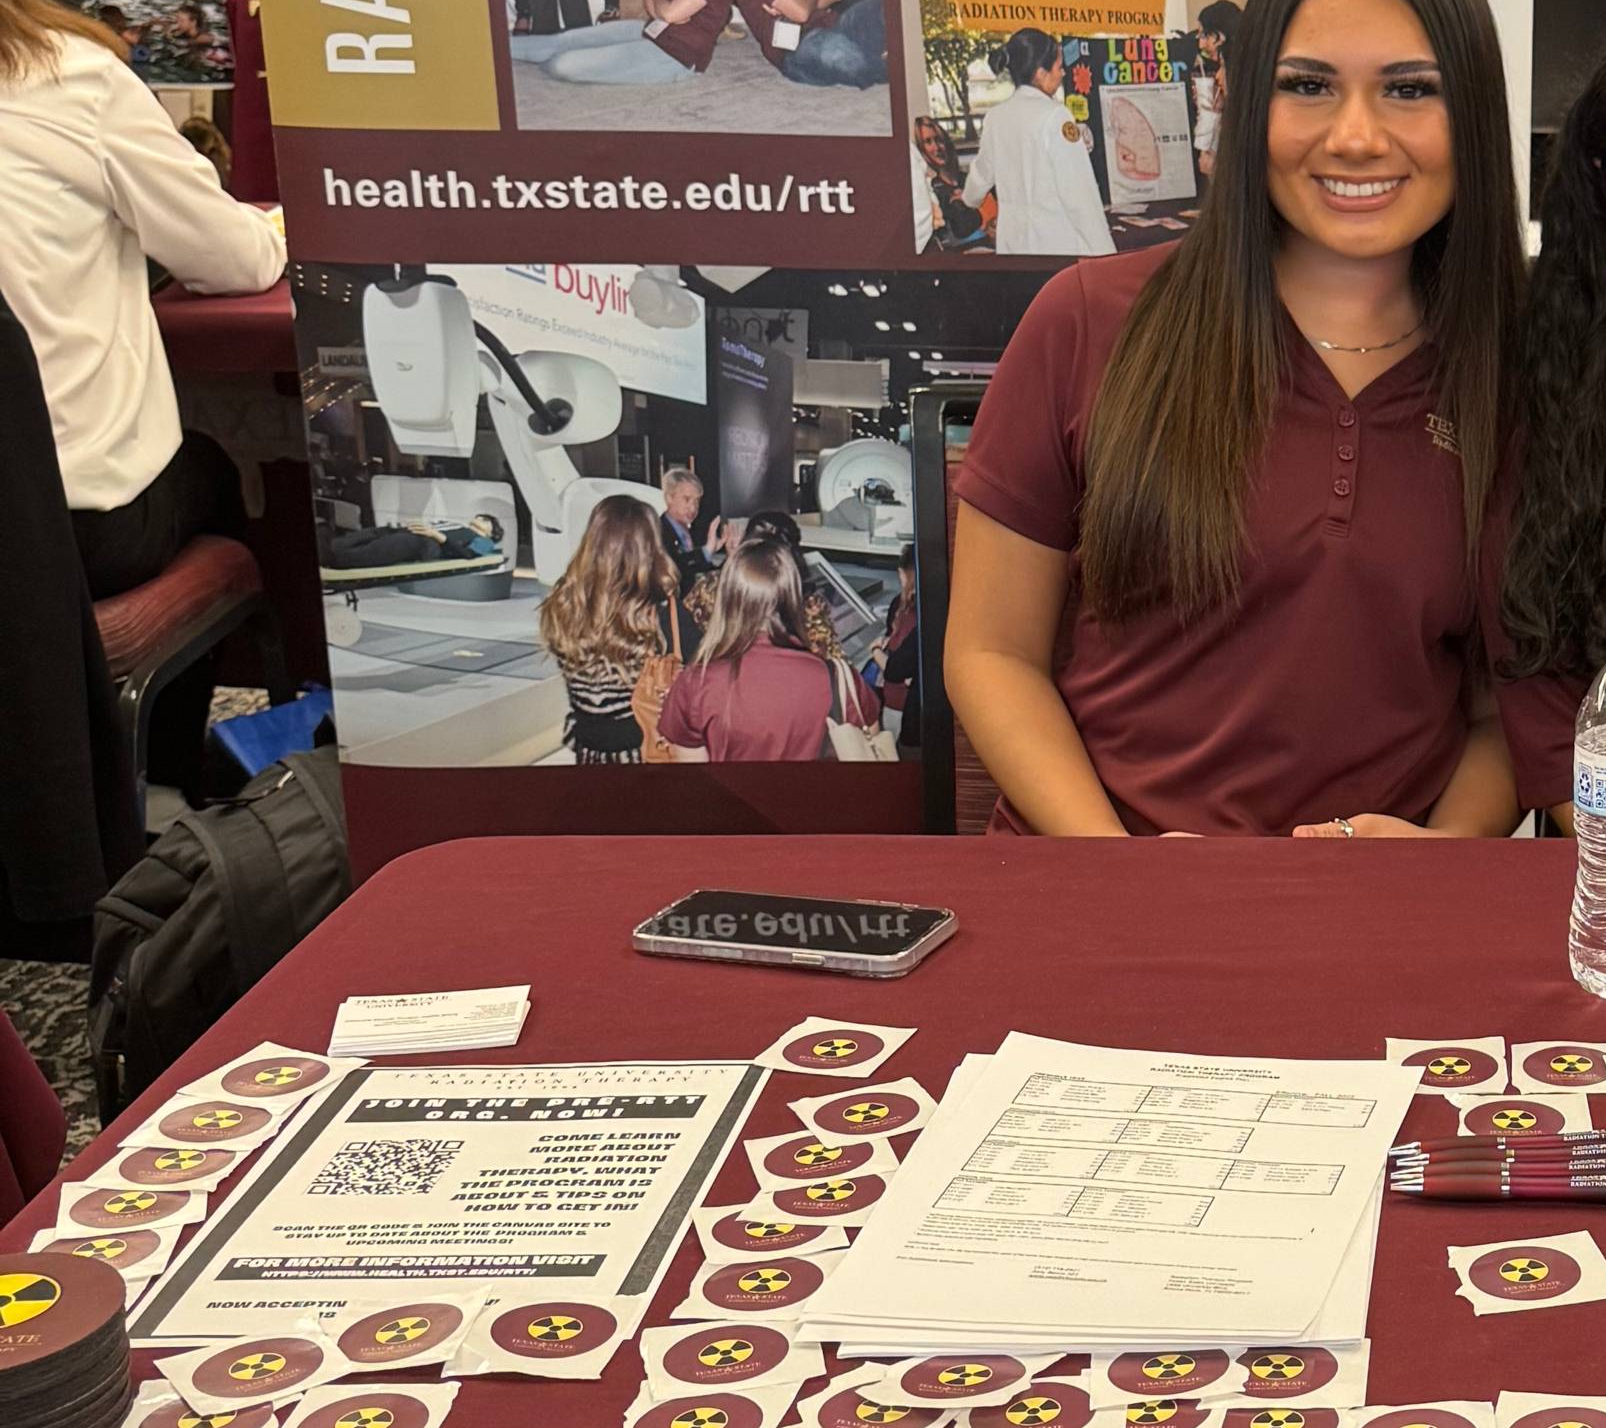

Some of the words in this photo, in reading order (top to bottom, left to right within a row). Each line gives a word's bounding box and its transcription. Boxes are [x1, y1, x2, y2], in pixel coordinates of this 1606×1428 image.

[949, 2, 1037, 20] RADIATION
[1040, 6, 1104, 23] THERAPY
[323, 168, 855, 214] health.txstate.edu/rtt
[1426, 412, 1458, 438] TEX
[365, 1099, 446, 1109] JOIN
[465, 1097, 529, 1107] THE
[545, 1095, 701, 1107] PRE-RTT
[424, 1110, 509, 1120] ORG.
[529, 1108, 625, 1119] NOW!
[234, 1258, 282, 1268] FOR
[287, 1258, 357, 1268] MORE
[358, 1255, 529, 1267] INFORMATION
[531, 1255, 595, 1265] VISIT
